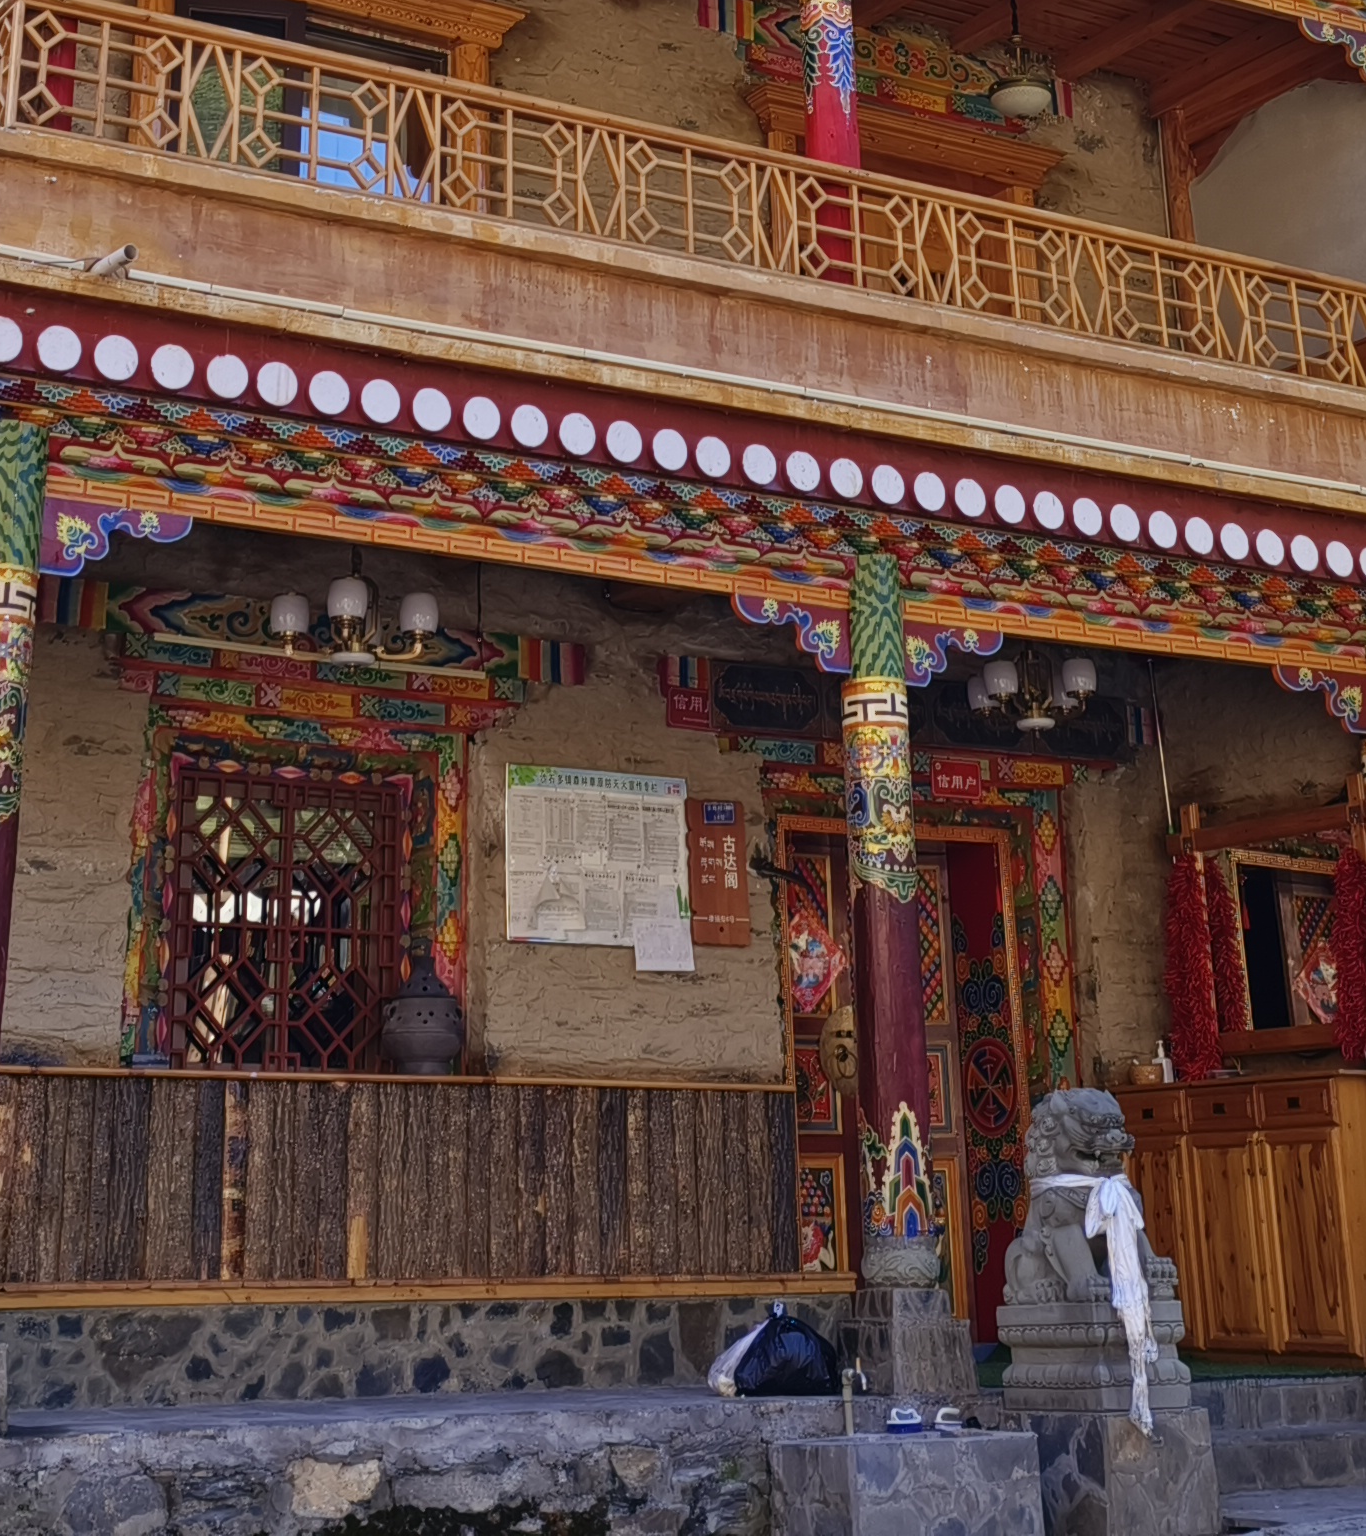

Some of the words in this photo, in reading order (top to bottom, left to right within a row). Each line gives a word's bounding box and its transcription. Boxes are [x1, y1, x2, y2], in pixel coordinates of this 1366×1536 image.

[673, 694, 709, 713] 信用
[937, 774, 976, 791] 信用户
[722, 834, 738, 889] 古达阁
